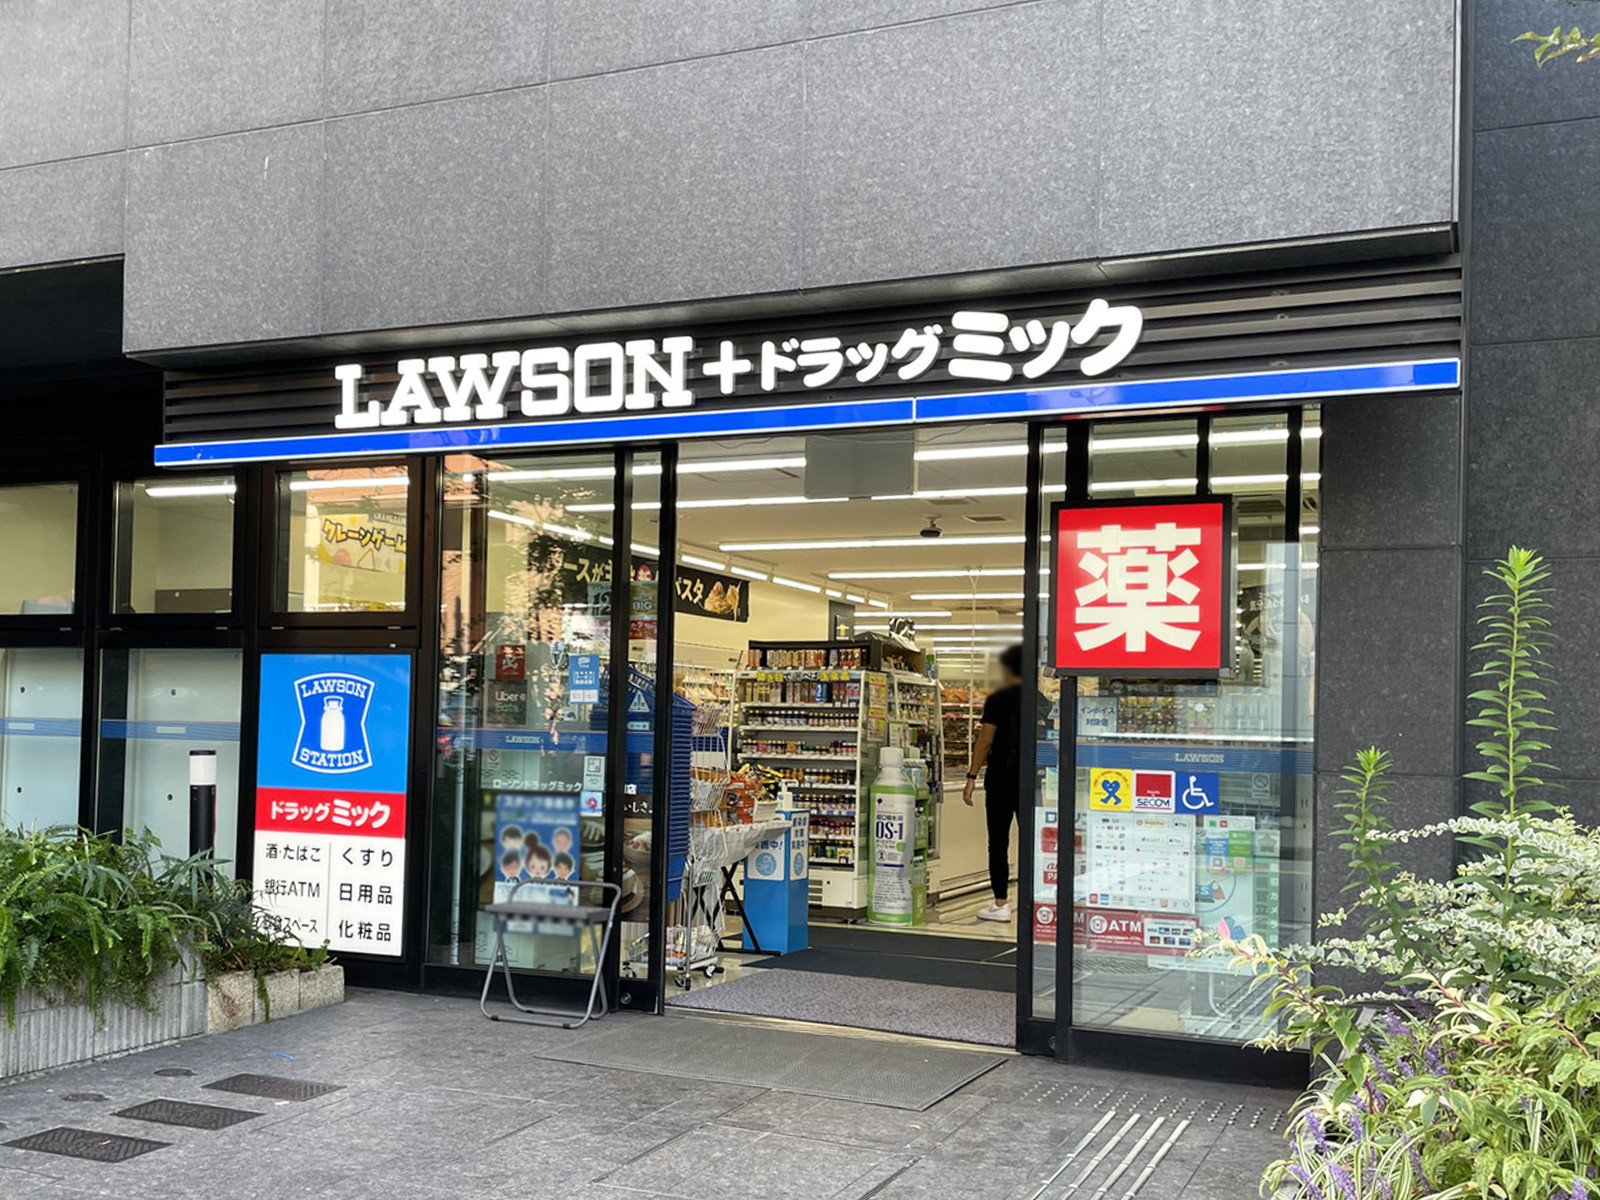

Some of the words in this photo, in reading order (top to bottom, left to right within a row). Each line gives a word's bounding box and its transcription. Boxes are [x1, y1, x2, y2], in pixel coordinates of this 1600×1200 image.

[334, 336, 693, 428] LAWSON
[760, 299, 1142, 390] ドラッグミック
[322, 518, 406, 554] クレーンゲーム
[1074, 522, 1201, 652] 薬
[301, 679, 368, 700] LAWSON
[495, 691, 518, 701] Uber
[495, 702, 519, 713] Eats
[1081, 706, 1115, 714] インボイス
[505, 735, 540, 744] LAWSON
[299, 747, 365, 767] STATION
[1174, 752, 1224, 763] LAWSON
[493, 779, 582, 792] ローソンドラッグミック
[1137, 798, 1170, 807] SECOM
[271, 799, 391, 828] ドラッグミック
[876, 821, 903, 840] OS-1
[342, 847, 394, 867] くすり
[264, 879, 320, 898] 銀行ATM
[339, 883, 393, 905] 日用品
[339, 920, 391, 942] 化粧品
[1108, 920, 1142, 932] ATM
